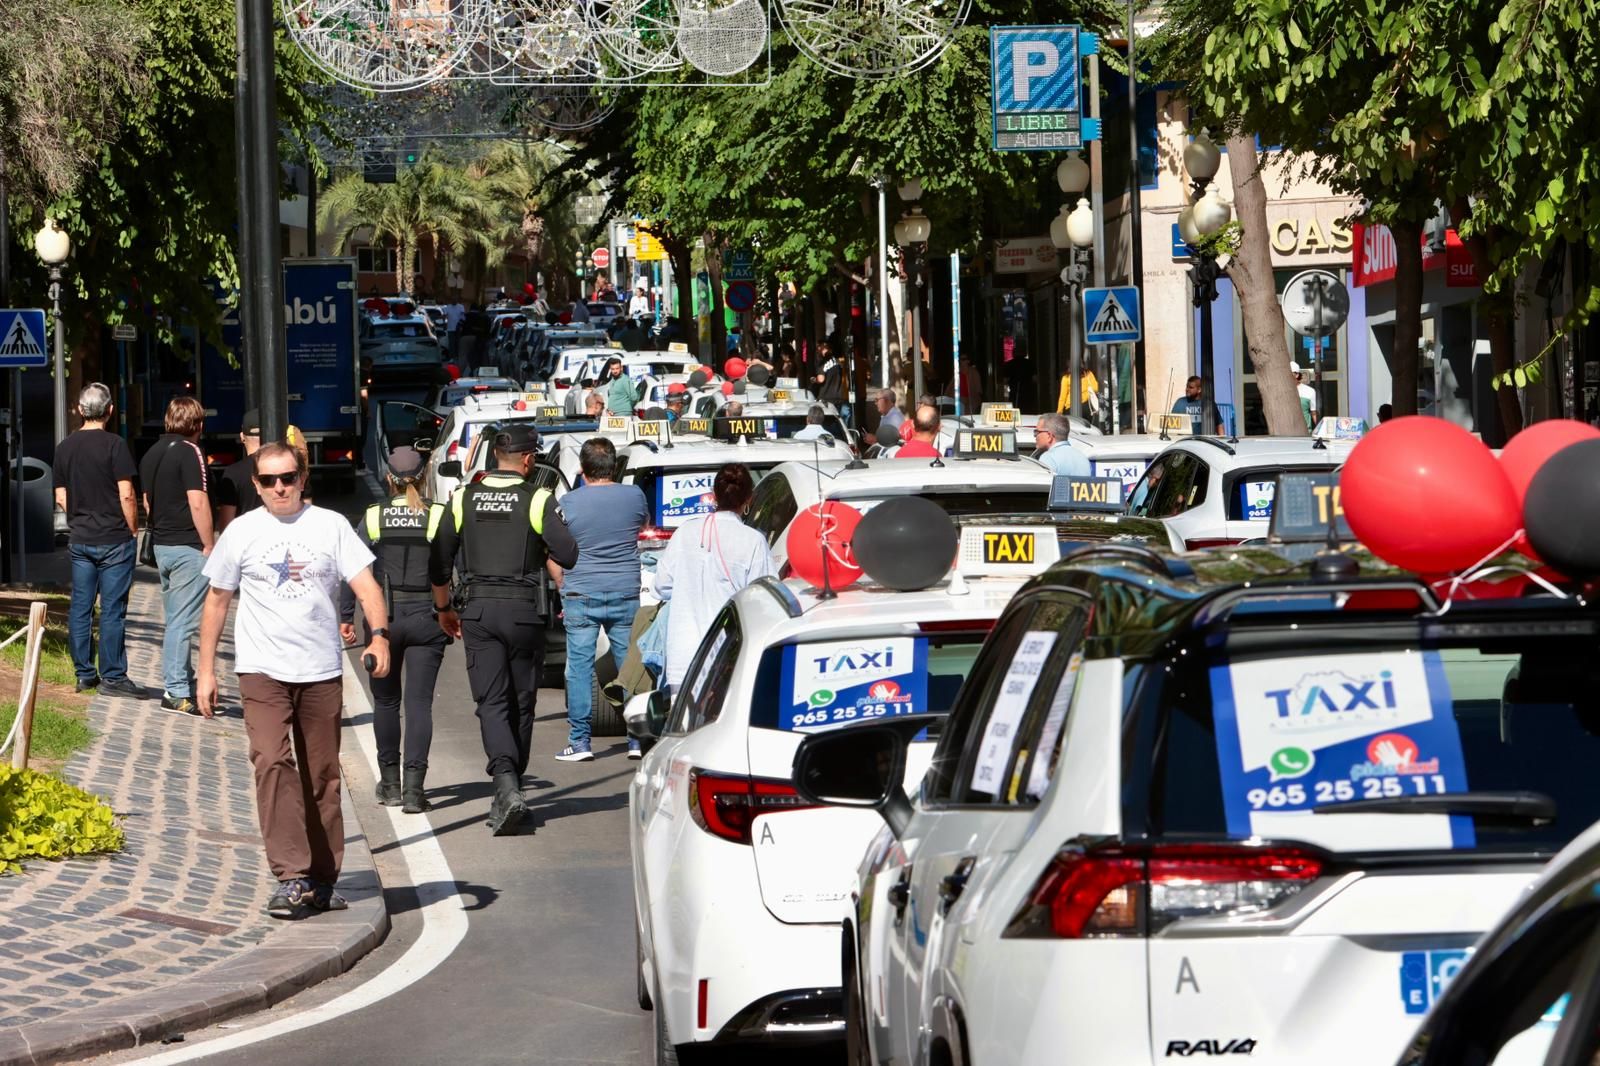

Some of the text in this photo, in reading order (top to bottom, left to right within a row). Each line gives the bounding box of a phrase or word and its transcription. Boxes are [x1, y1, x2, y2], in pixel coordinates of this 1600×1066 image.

[1012, 41, 1059, 102] P
[1006, 115, 1067, 130] LIBRE
[543, 407, 558, 417] TAXI
[996, 410, 1013, 422] TAXI
[1186, 406, 1202, 414] NIK
[608, 418, 624, 428] TAXI
[688, 420, 707, 431] TAXI
[729, 420, 755, 434] TAXI
[973, 435, 1002, 451] TAXI
[472, 492, 519, 502] POLICIA
[1071, 482, 1106, 502] TAXI
[476, 502, 513, 512] LOCAL
[662, 508, 680, 516] 965
[385, 518, 422, 527] LOCAL
[984, 534, 1034, 562] TAXI
[792, 702, 914, 727] 965 25 25 11
[1247, 774, 1447, 810] 965 25 25 11
[1175, 956, 1200, 994] A
[1409, 989, 1423, 1005] E
[1165, 1038, 1257, 1058] RAV4
